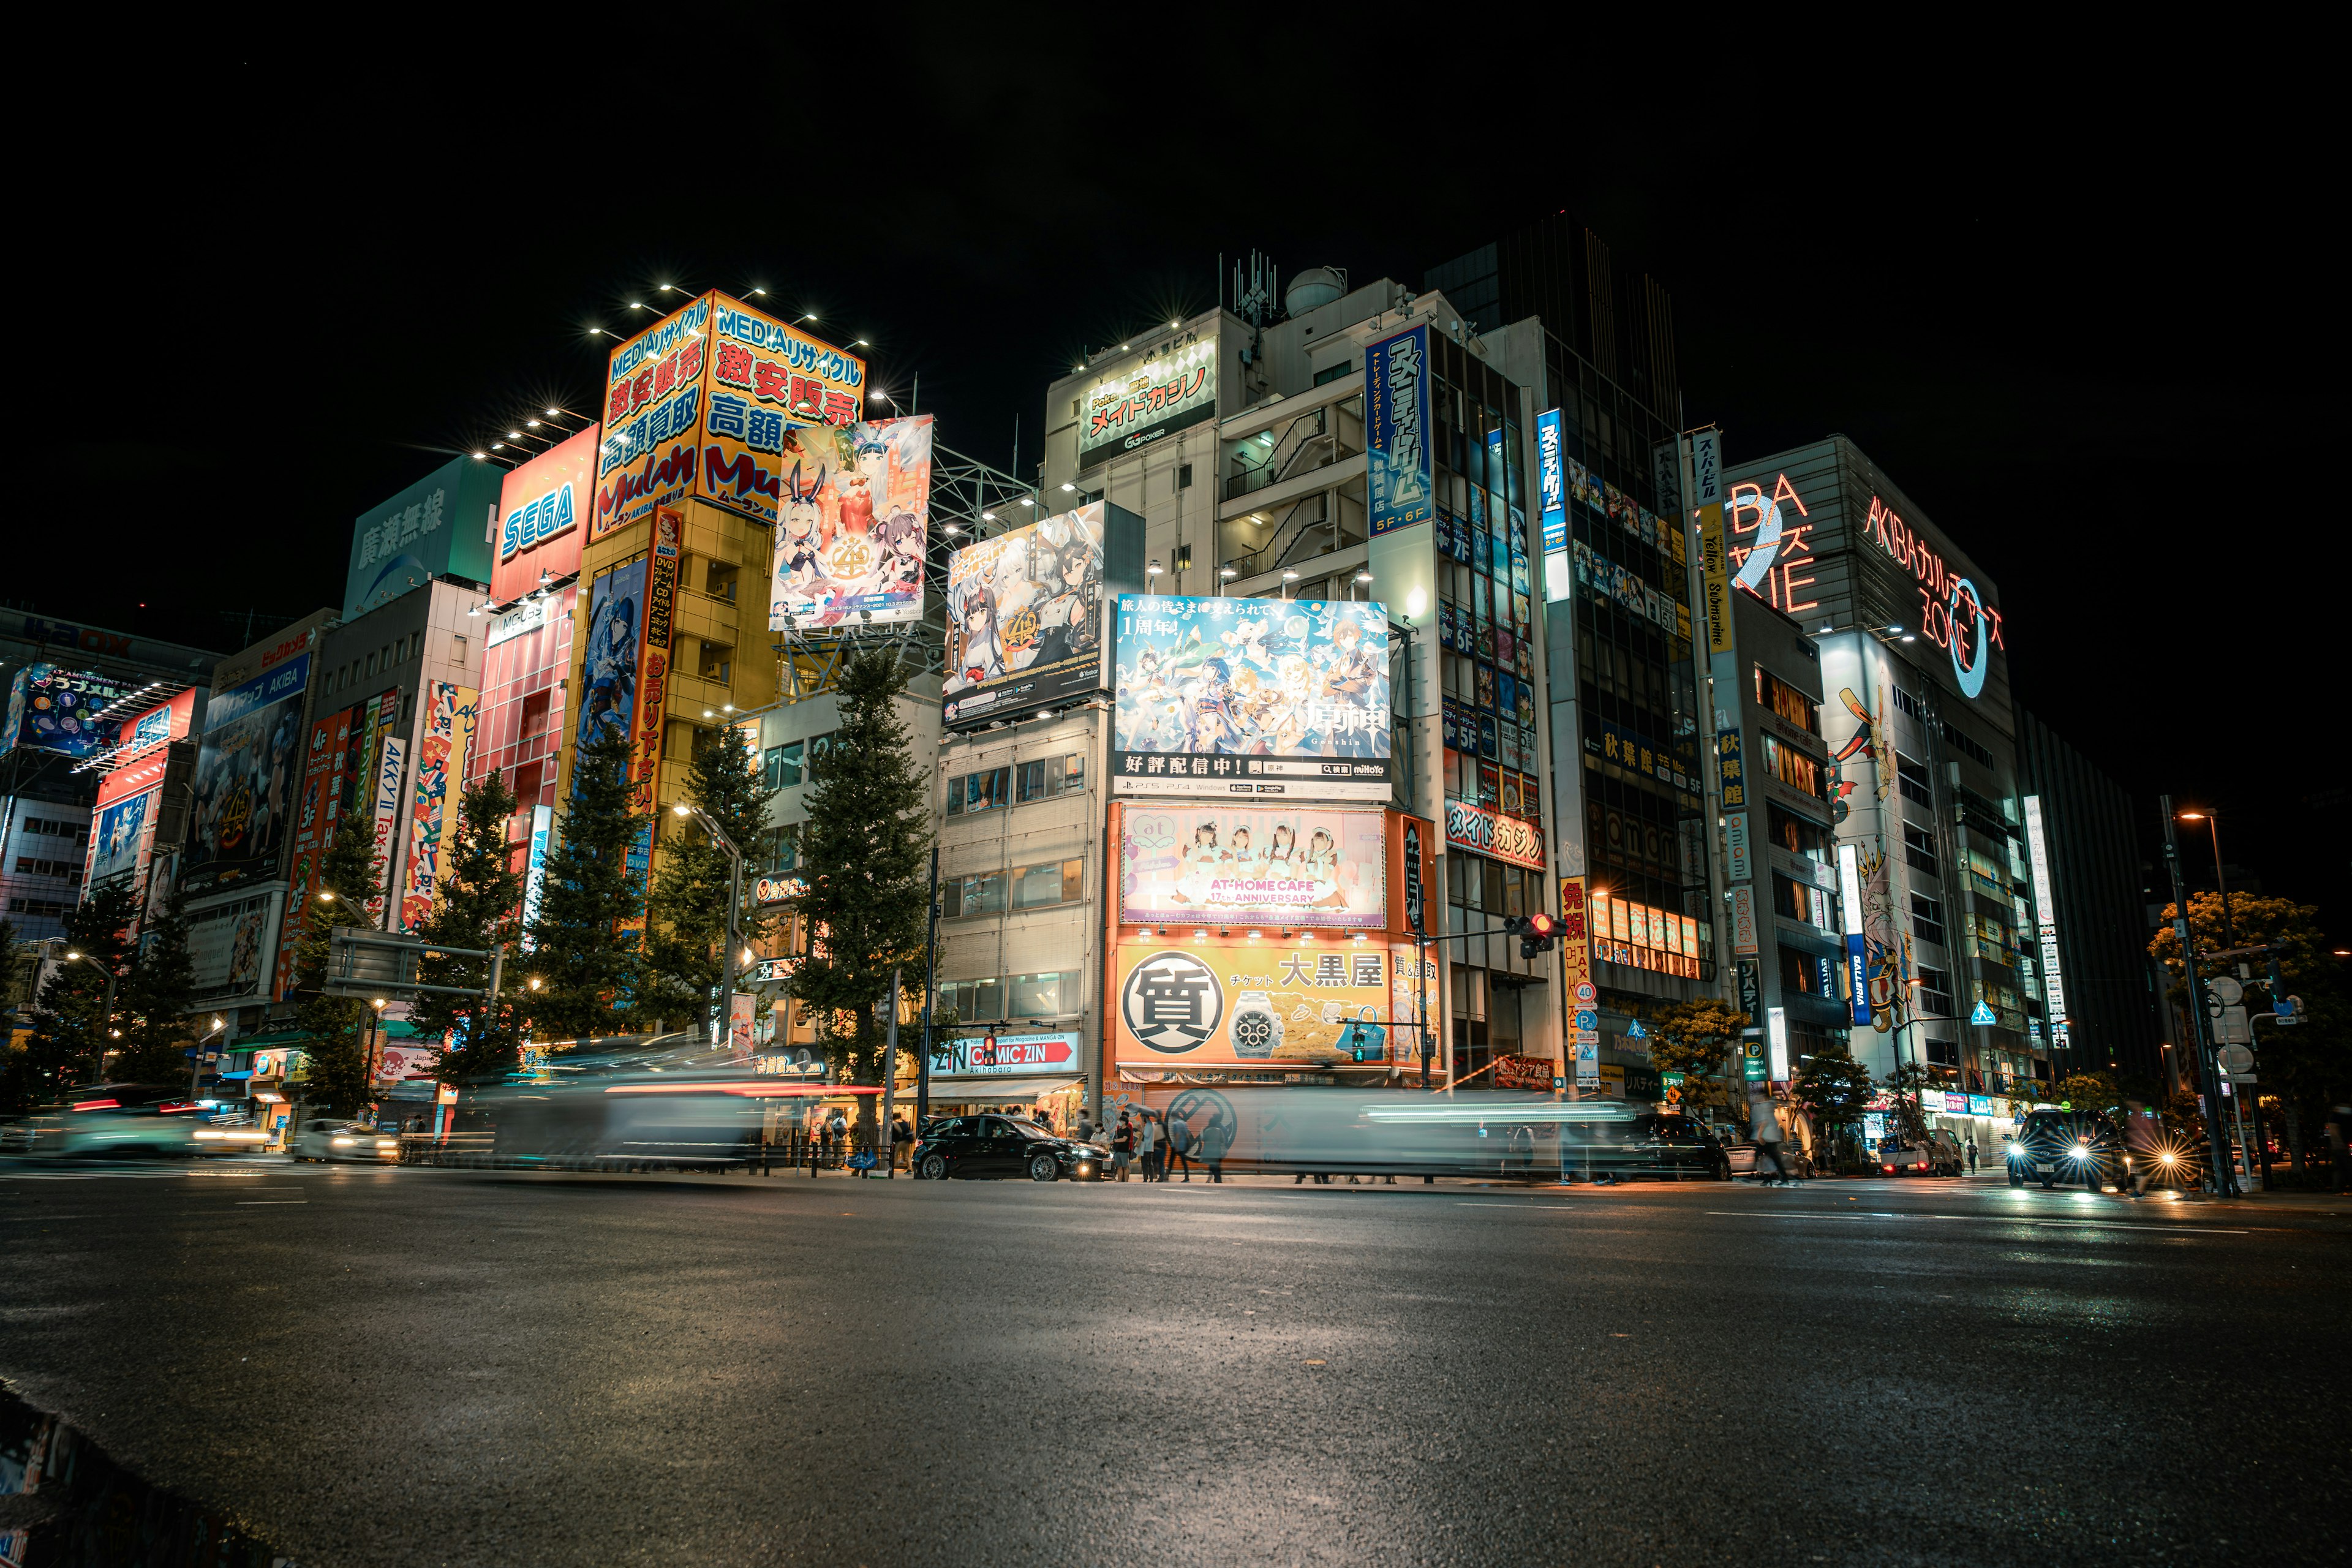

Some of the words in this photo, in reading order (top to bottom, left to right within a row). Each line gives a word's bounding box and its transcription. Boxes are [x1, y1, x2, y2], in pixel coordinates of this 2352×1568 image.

[717, 304, 861, 386] MEDIAリサイクル
[606, 337, 704, 428] 激安販売
[714, 340, 859, 427] 激安販売
[1090, 366, 1205, 438] メイドカジノ
[702, 445, 780, 501] Mu
[1700, 439, 1716, 499] スーパービル
[597, 445, 696, 532] Mulan
[1374, 460, 1385, 513] 秋葉原店
[718, 489, 763, 513] ムーラン
[763, 508, 777, 519] AK
[358, 488, 445, 570] 廣瀬無線
[500, 481, 577, 560] SEGA
[603, 511, 631, 533] ムーラン
[631, 502, 652, 519] AKIBA
[1453, 537, 1469, 561] 7F
[1705, 535, 1717, 574] Yellow
[655, 567, 673, 579] ブルーレイ
[657, 557, 674, 569] DVD
[1864, 496, 2004, 651] AKIBAカルチャーズ
[654, 576, 673, 589] ゲーム
[656, 587, 668, 597] CD
[651, 606, 670, 617] アニメ
[652, 596, 671, 608] アイドル
[1709, 582, 1725, 646] Submarine
[651, 617, 668, 627] コミック
[651, 627, 667, 636] ホビー
[1918, 588, 1972, 671] ZONE
[262, 631, 307, 668] ビックカメラ
[649, 636, 666, 647] フィギュア
[1457, 629, 1473, 652] 6F
[66, 671, 120, 685] AMUSEMENT
[269, 668, 297, 694] AKIBA
[1303, 697, 1387, 754] 原神
[1460, 726, 1477, 749] 5F
[312, 728, 327, 752] 4F
[1311, 737, 1360, 746] Genshin
[310, 752, 331, 766] カードゲーム
[1604, 732, 1653, 775] 秋葉館
[1657, 753, 1670, 769] 中古
[1672, 759, 1686, 775] Mac
[308, 763, 330, 777] オンラインゲーム
[382, 741, 401, 799] AKKY
[1333, 765, 1350, 774] 検索
[1354, 764, 1384, 774] miHoYo
[1721, 734, 1744, 806] 秋葉館
[1691, 777, 1701, 794] 5F
[301, 805, 315, 829] 3F
[1144, 822, 1163, 835] at
[1447, 805, 1543, 861] メイドカジノ
[638, 846, 650, 856] 中古
[1731, 816, 1746, 878] amiami
[628, 859, 648, 869] DVD
[1211, 879, 1276, 892] AT-HOME
[1276, 880, 1314, 892] CAFE
[1211, 892, 1231, 902] 17th
[1235, 892, 1314, 903] ANNIVERSARY
[288, 889, 303, 914] 2F
[1562, 882, 1586, 941] 免税
[286, 917, 301, 927] プライズ
[1594, 911, 1605, 922] Tax
[1594, 922, 1607, 933] Free
[1736, 889, 1752, 943] あみあみ
[284, 929, 306, 939] レトロゲーム
[1630, 910, 1678, 950] あみあみ
[1230, 974, 1273, 987] チケット
[1279, 952, 1384, 989] 大黒屋
[1577, 945, 1588, 979] TAX
[1579, 987, 1591, 997] 40
[1853, 955, 1864, 1006] GALLERIA
[1135, 967, 1216, 1042] 質
[1580, 1016, 1589, 1030] P
[971, 1045, 1021, 1065] CMIC
[1024, 1044, 1046, 1062] ZIN
[970, 1065, 1011, 1074] Akihabara
[1626, 1076, 1659, 1091] リバティー
